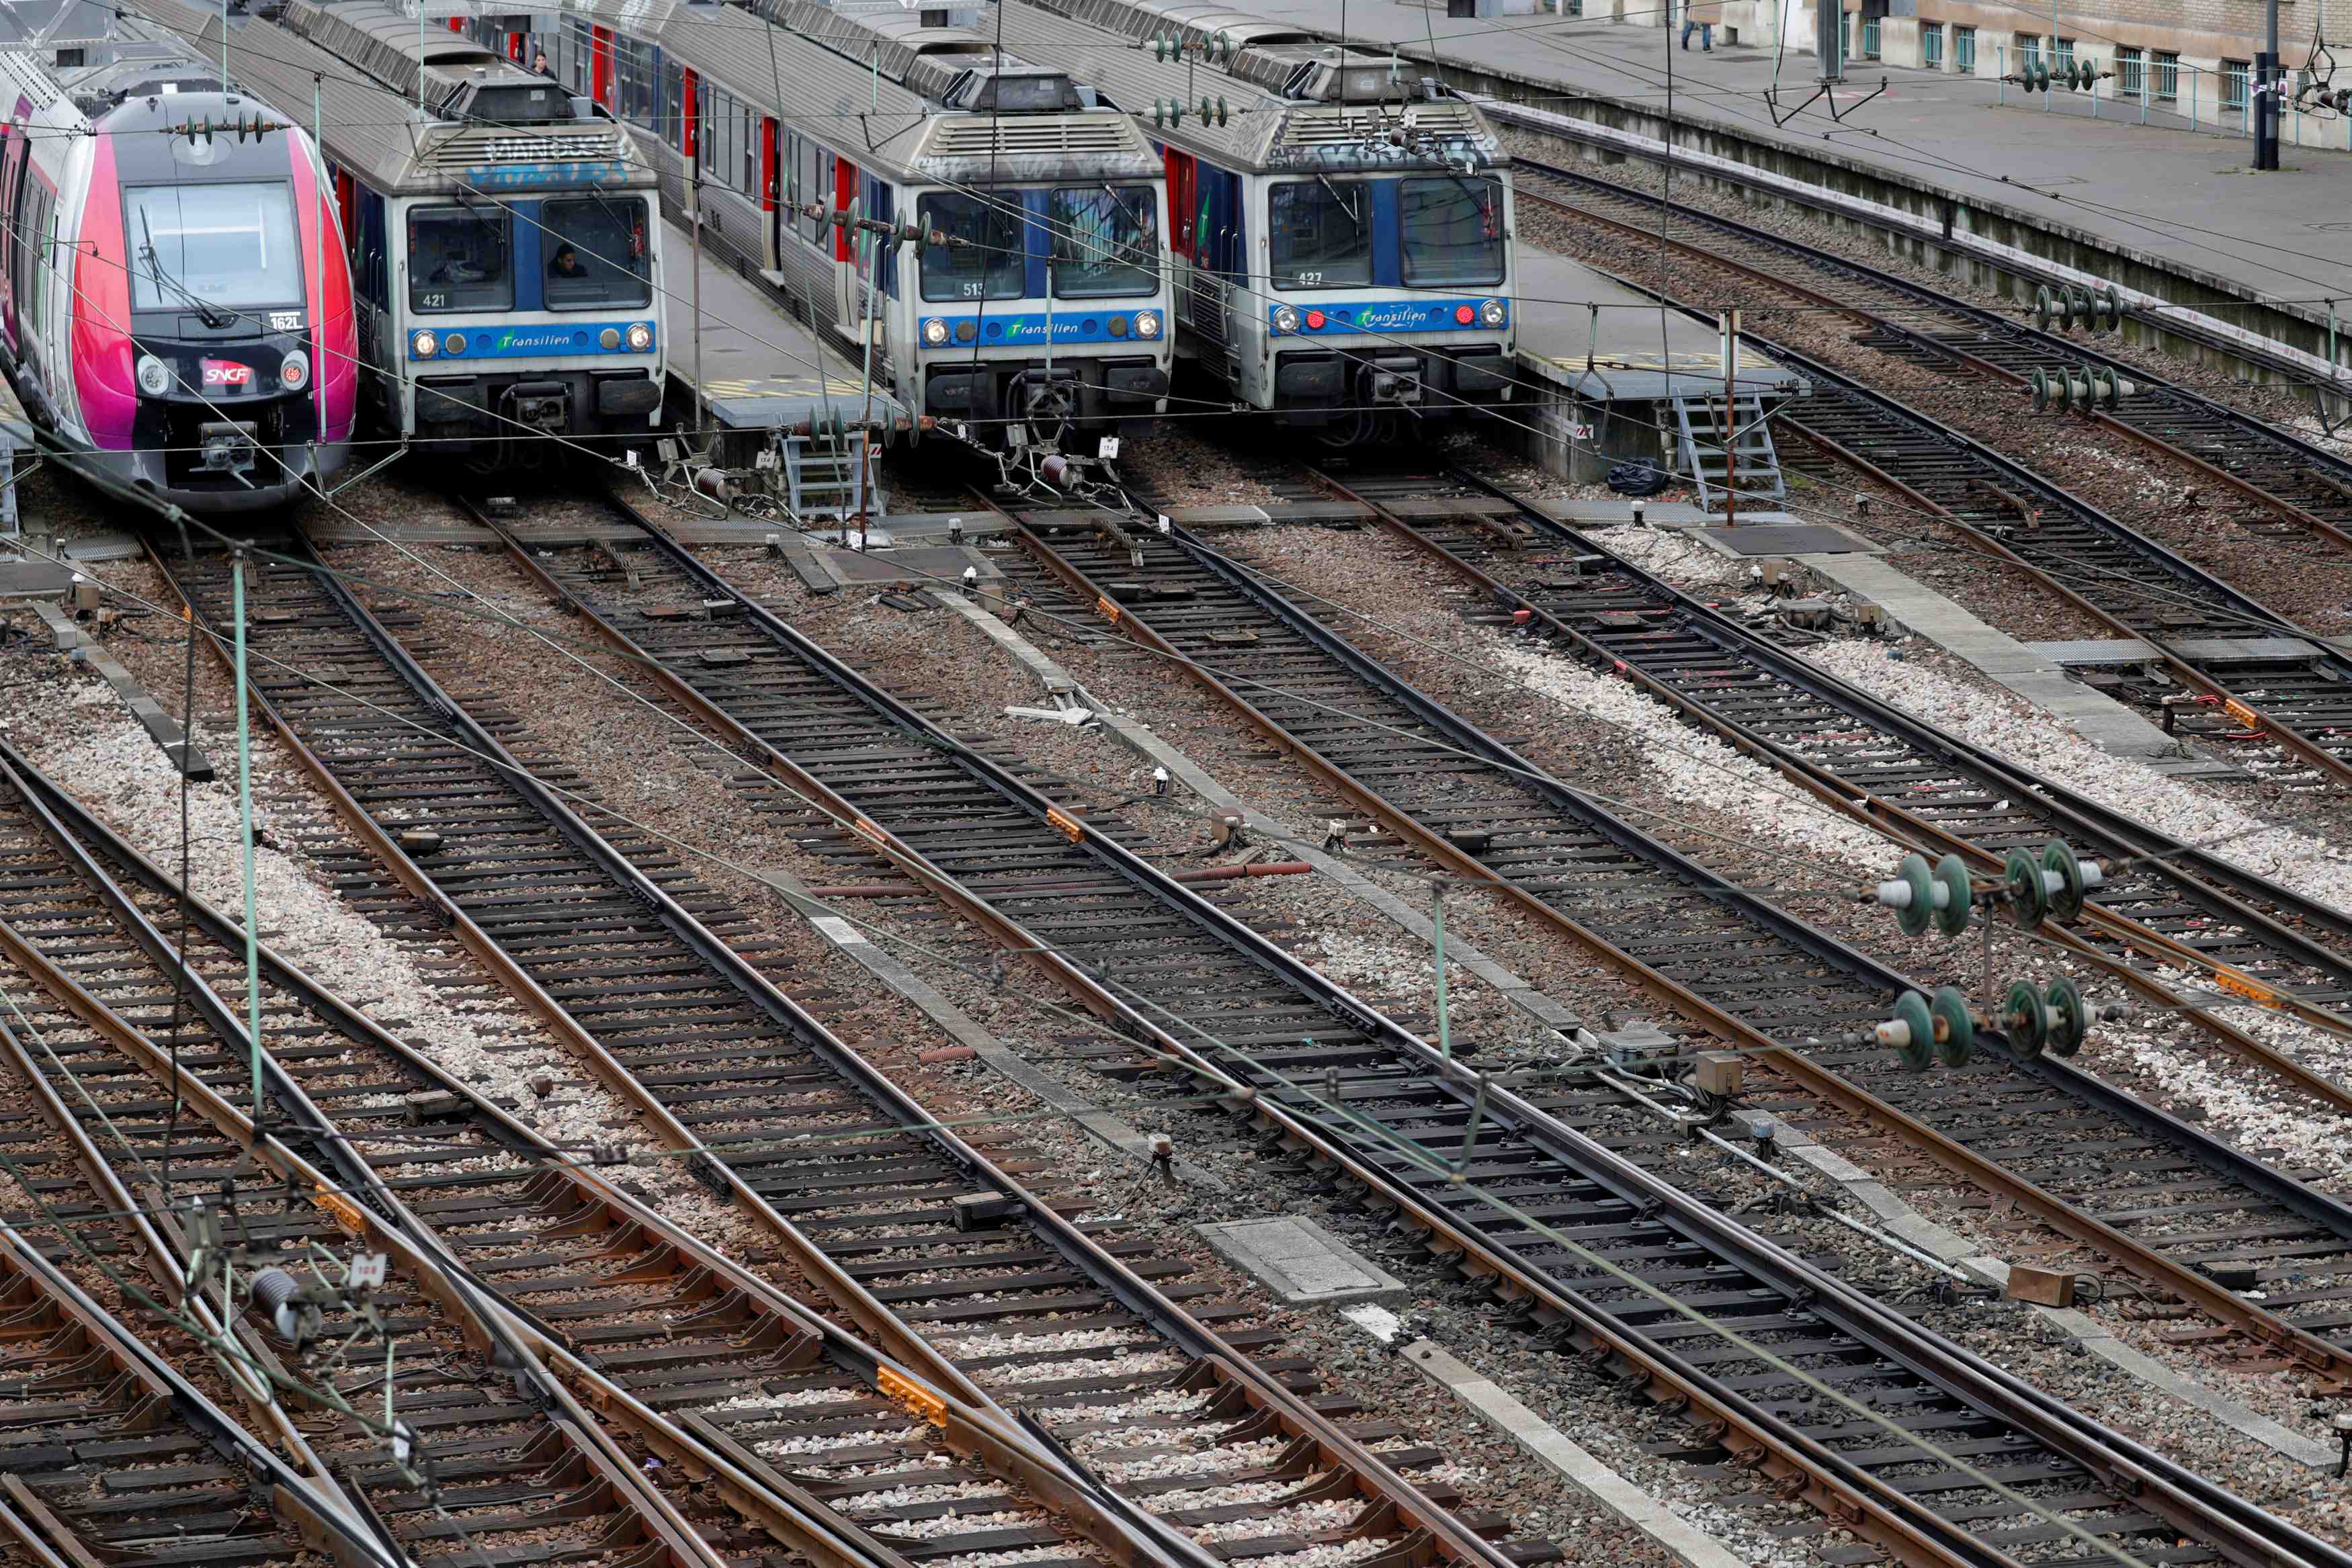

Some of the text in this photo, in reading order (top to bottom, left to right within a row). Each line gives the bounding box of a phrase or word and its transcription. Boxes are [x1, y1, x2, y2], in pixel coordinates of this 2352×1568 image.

[1300, 272, 1322, 285] 427
[423, 294, 444, 306] 421
[271, 316, 303, 330] 162L
[503, 335, 570, 347] Transilien
[205, 368, 248, 382] SNCF
